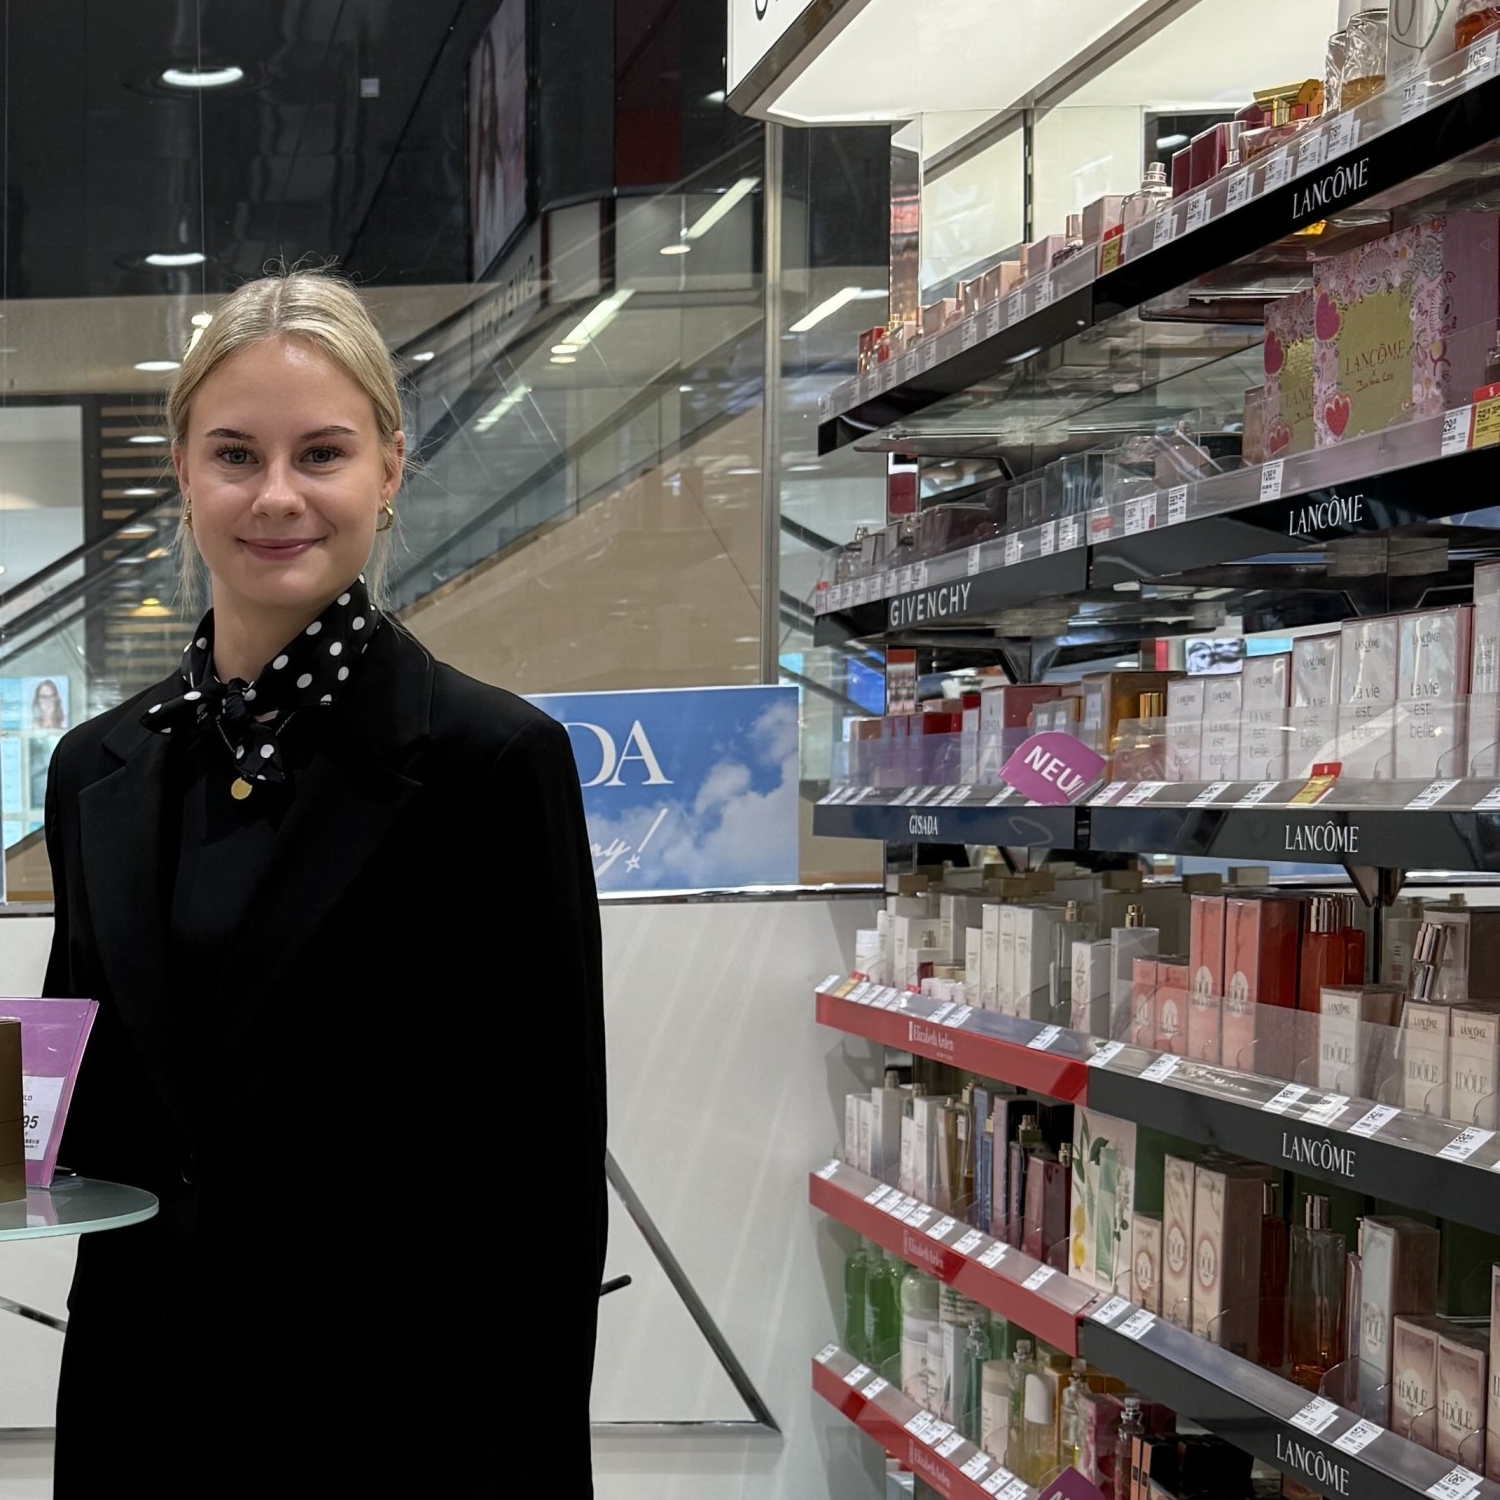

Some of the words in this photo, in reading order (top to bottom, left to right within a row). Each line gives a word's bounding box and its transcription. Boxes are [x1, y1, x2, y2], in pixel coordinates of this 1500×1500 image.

[1292, 157, 1369, 220] LANCÔME
[1344, 340, 1405, 376] LANCÔME
[1288, 494, 1364, 537] LANCÔME
[890, 581, 972, 628] GIVENCHY
[1413, 702, 1432, 716] est
[1023, 744, 1079, 794] NEU
[908, 814, 939, 836] GISADA
[1284, 820, 1360, 853] LANCÔME
[1460, 1024, 1487, 1039] LANCÔME
[1454, 1068, 1488, 1095] IDÔLE
[1281, 1131, 1356, 1178] LANCÔME
[1398, 1379, 1429, 1408] IDÔLE
[1441, 1398, 1473, 1430] IDÔLE
[1276, 1433, 1350, 1497] LANCÔME
